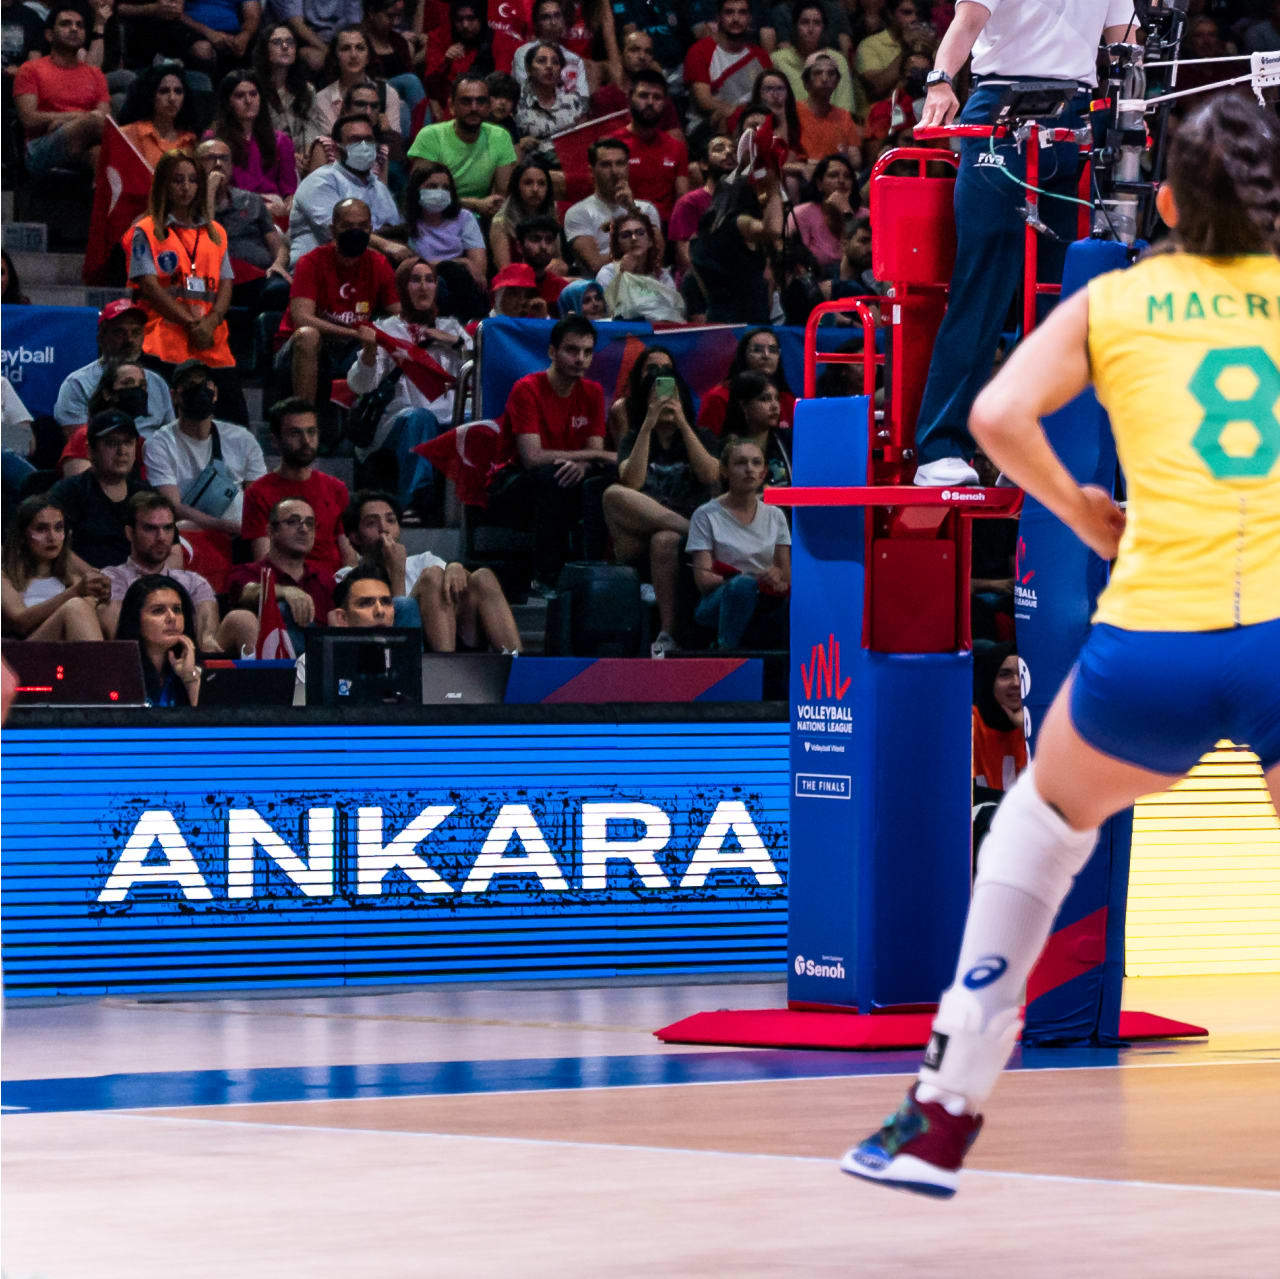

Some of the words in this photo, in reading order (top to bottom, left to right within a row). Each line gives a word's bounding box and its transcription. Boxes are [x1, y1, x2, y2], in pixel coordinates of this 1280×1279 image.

[952, 492, 985, 501] Senoh
[801, 634, 852, 700] VNL
[797, 705, 852, 721] VOLLEYBALL
[797, 721, 826, 732] NATIONS
[828, 723, 852, 733] LEAGUE
[802, 780, 817, 790] THE
[819, 781, 845, 792] FINALS
[98, 801, 784, 903] ANKARA
[806, 959, 845, 979] Senoh
